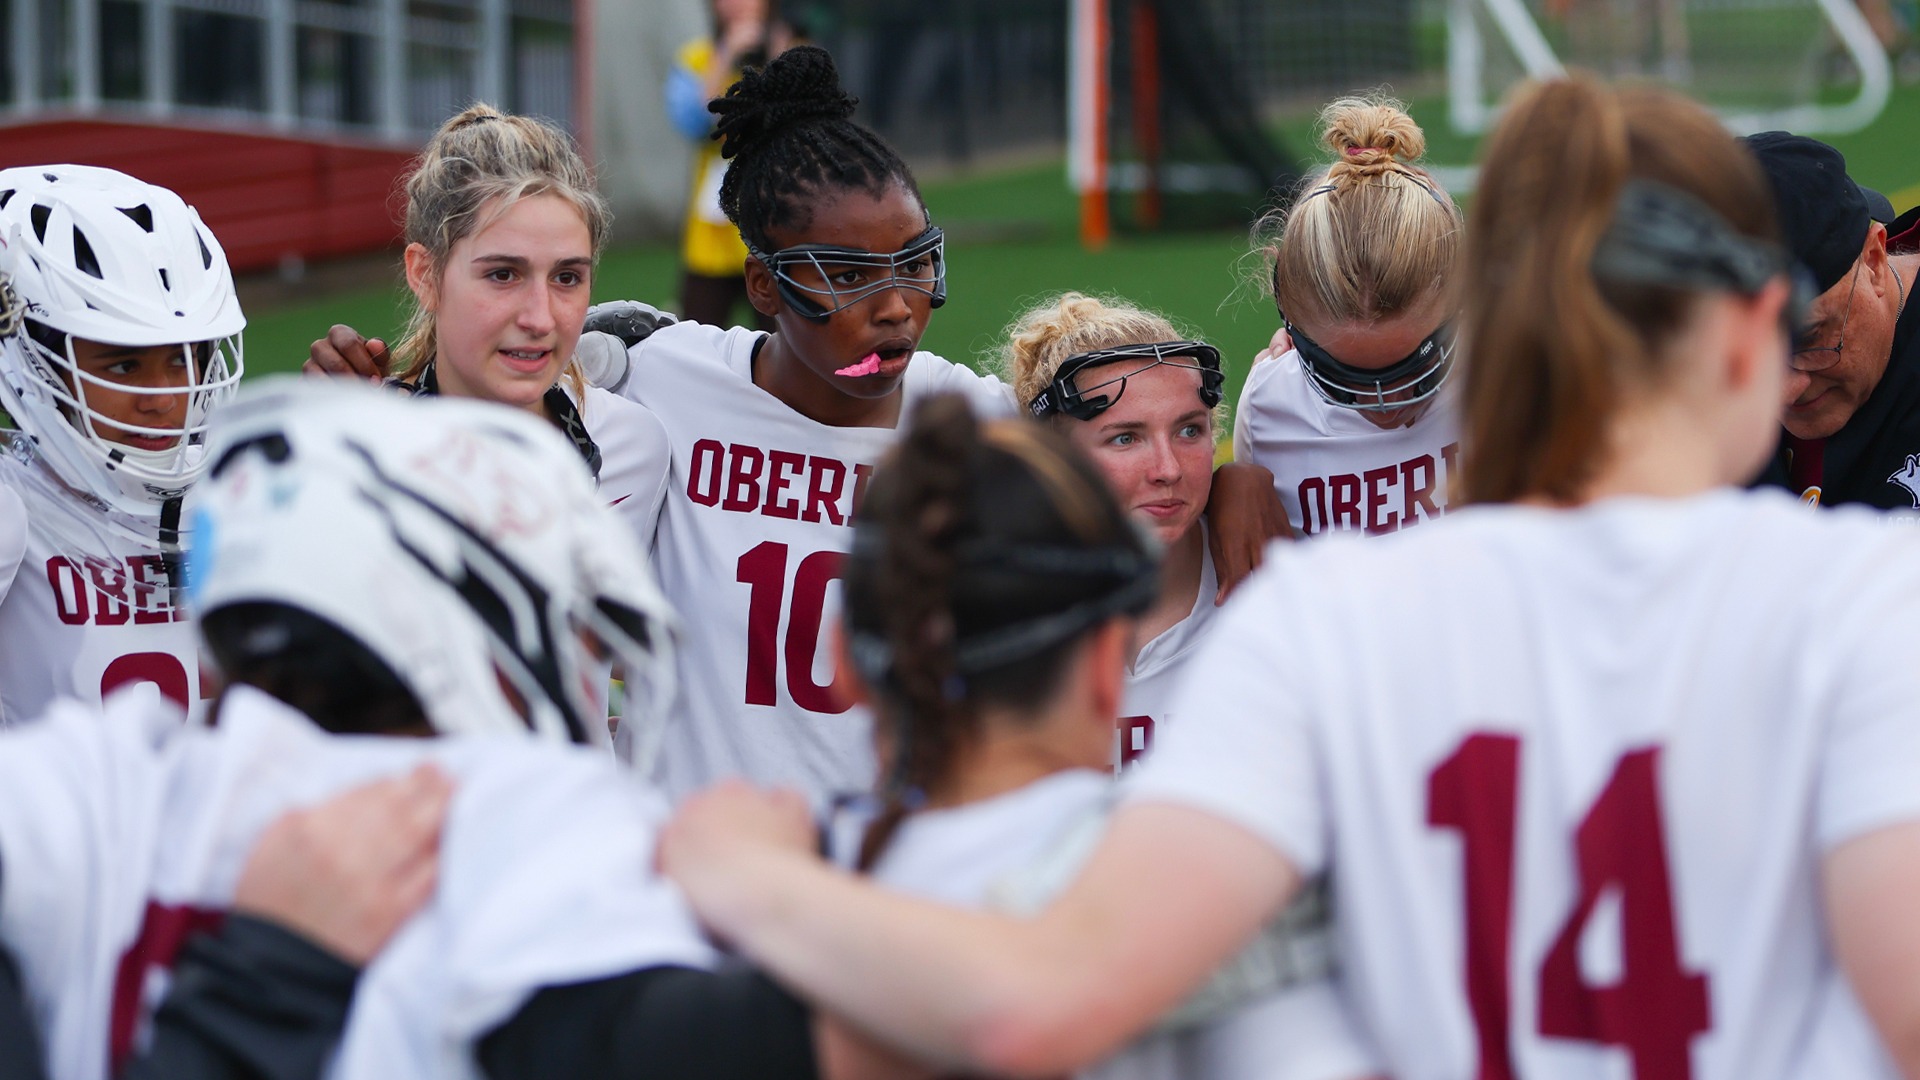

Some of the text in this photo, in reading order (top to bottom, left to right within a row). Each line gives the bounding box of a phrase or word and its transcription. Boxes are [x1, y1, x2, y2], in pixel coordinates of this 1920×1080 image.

[1032, 392, 1050, 416] GAIT
[46, 555, 190, 626] OBE
[736, 541, 858, 714] 10
[1426, 733, 1712, 1080] 14
